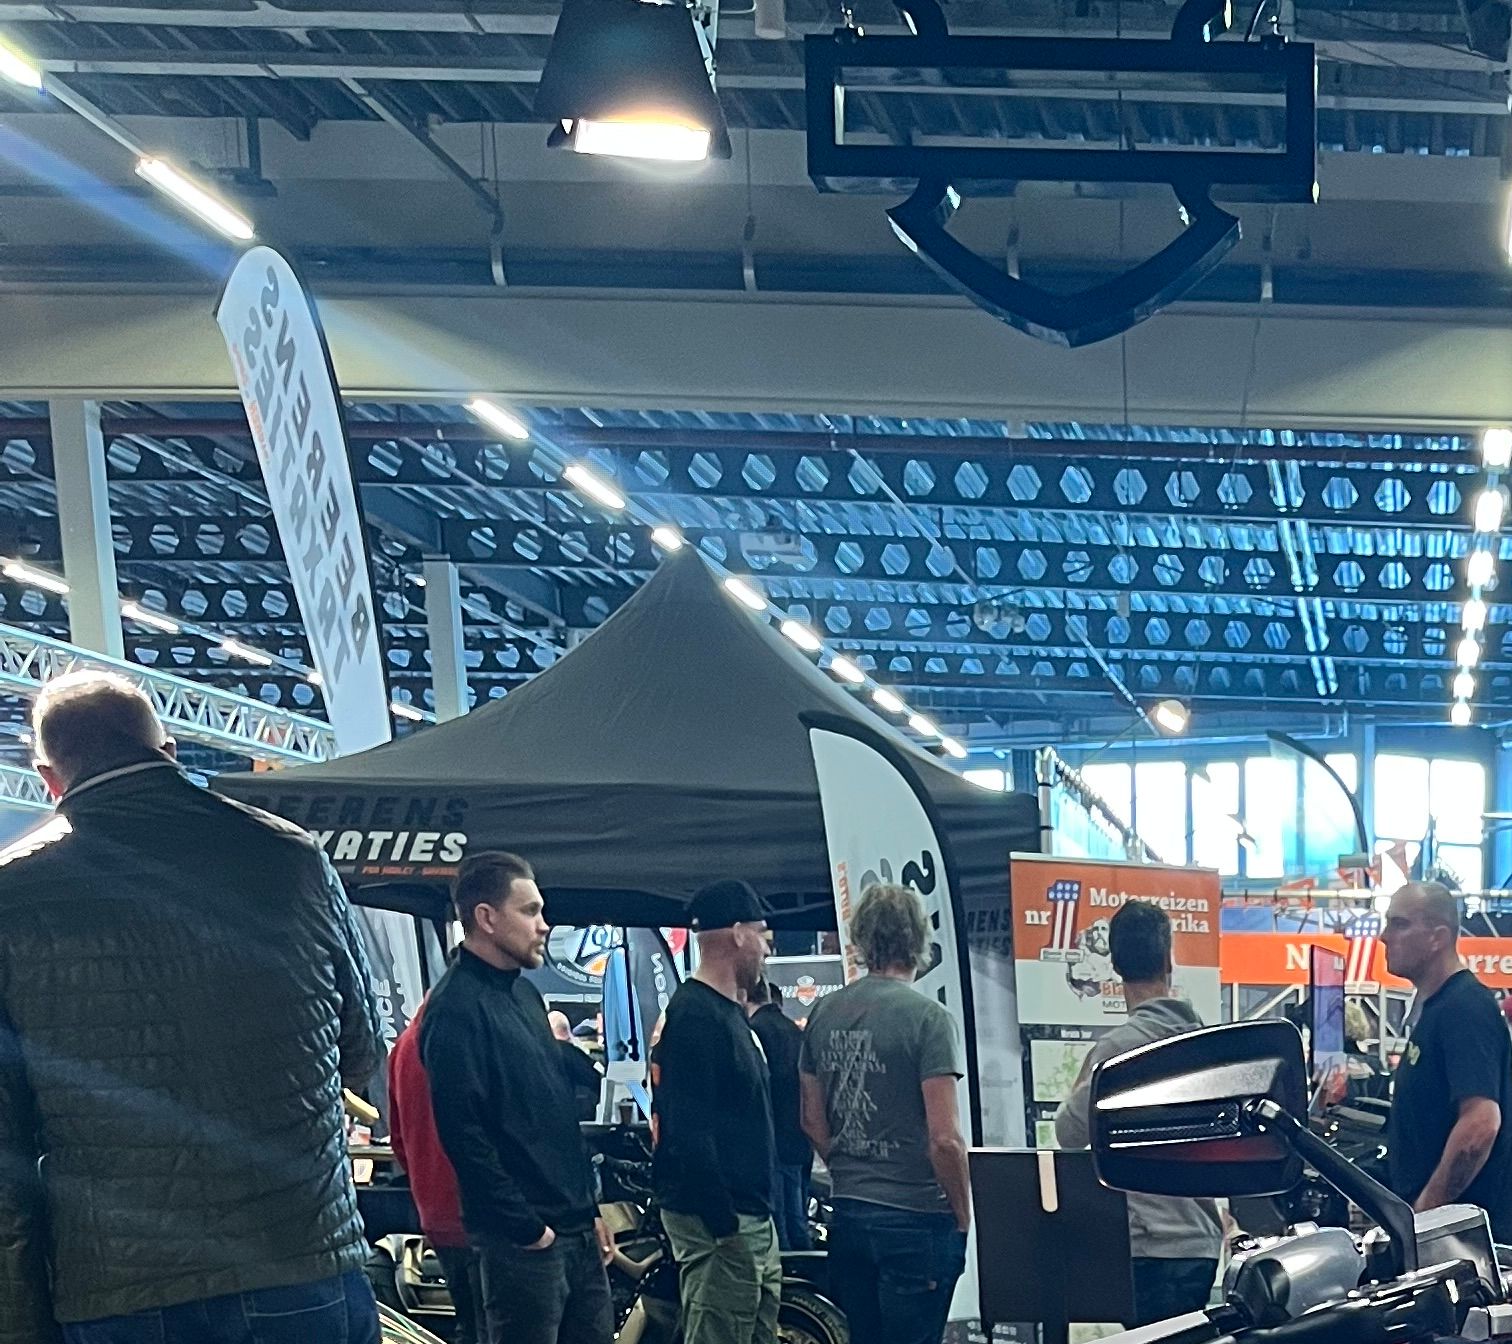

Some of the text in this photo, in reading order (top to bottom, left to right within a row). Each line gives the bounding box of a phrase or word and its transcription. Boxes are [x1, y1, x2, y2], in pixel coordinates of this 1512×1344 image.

[308, 830, 468, 862] XATIES
[1089, 887, 1209, 913] Motreizen
[1024, 909, 1051, 925] nr
[1171, 913, 1210, 933] rika
